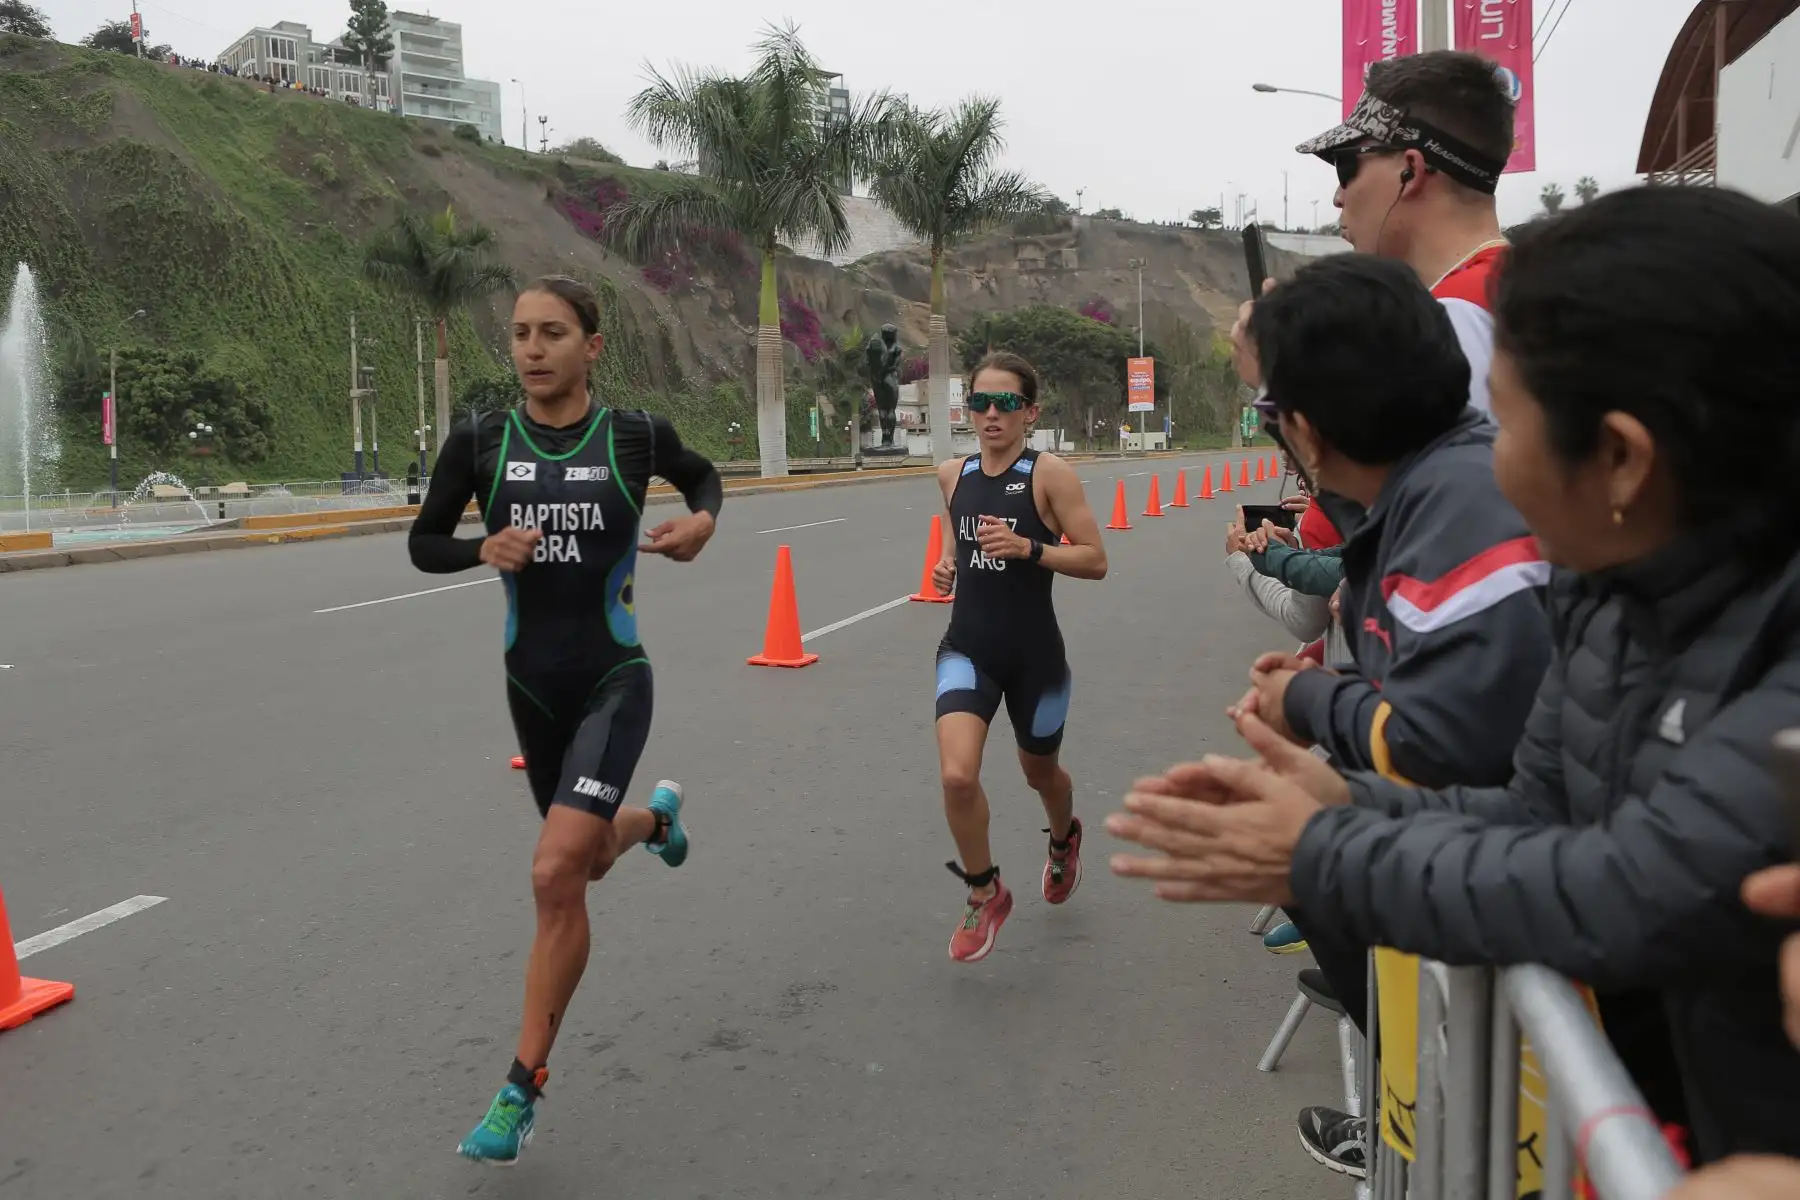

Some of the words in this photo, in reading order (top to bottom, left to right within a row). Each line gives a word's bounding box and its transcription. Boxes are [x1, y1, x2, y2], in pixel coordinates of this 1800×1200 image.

[510, 502, 605, 531] BAPTISTA
[533, 534, 582, 563] BRA
[970, 549, 1006, 571] ARG
